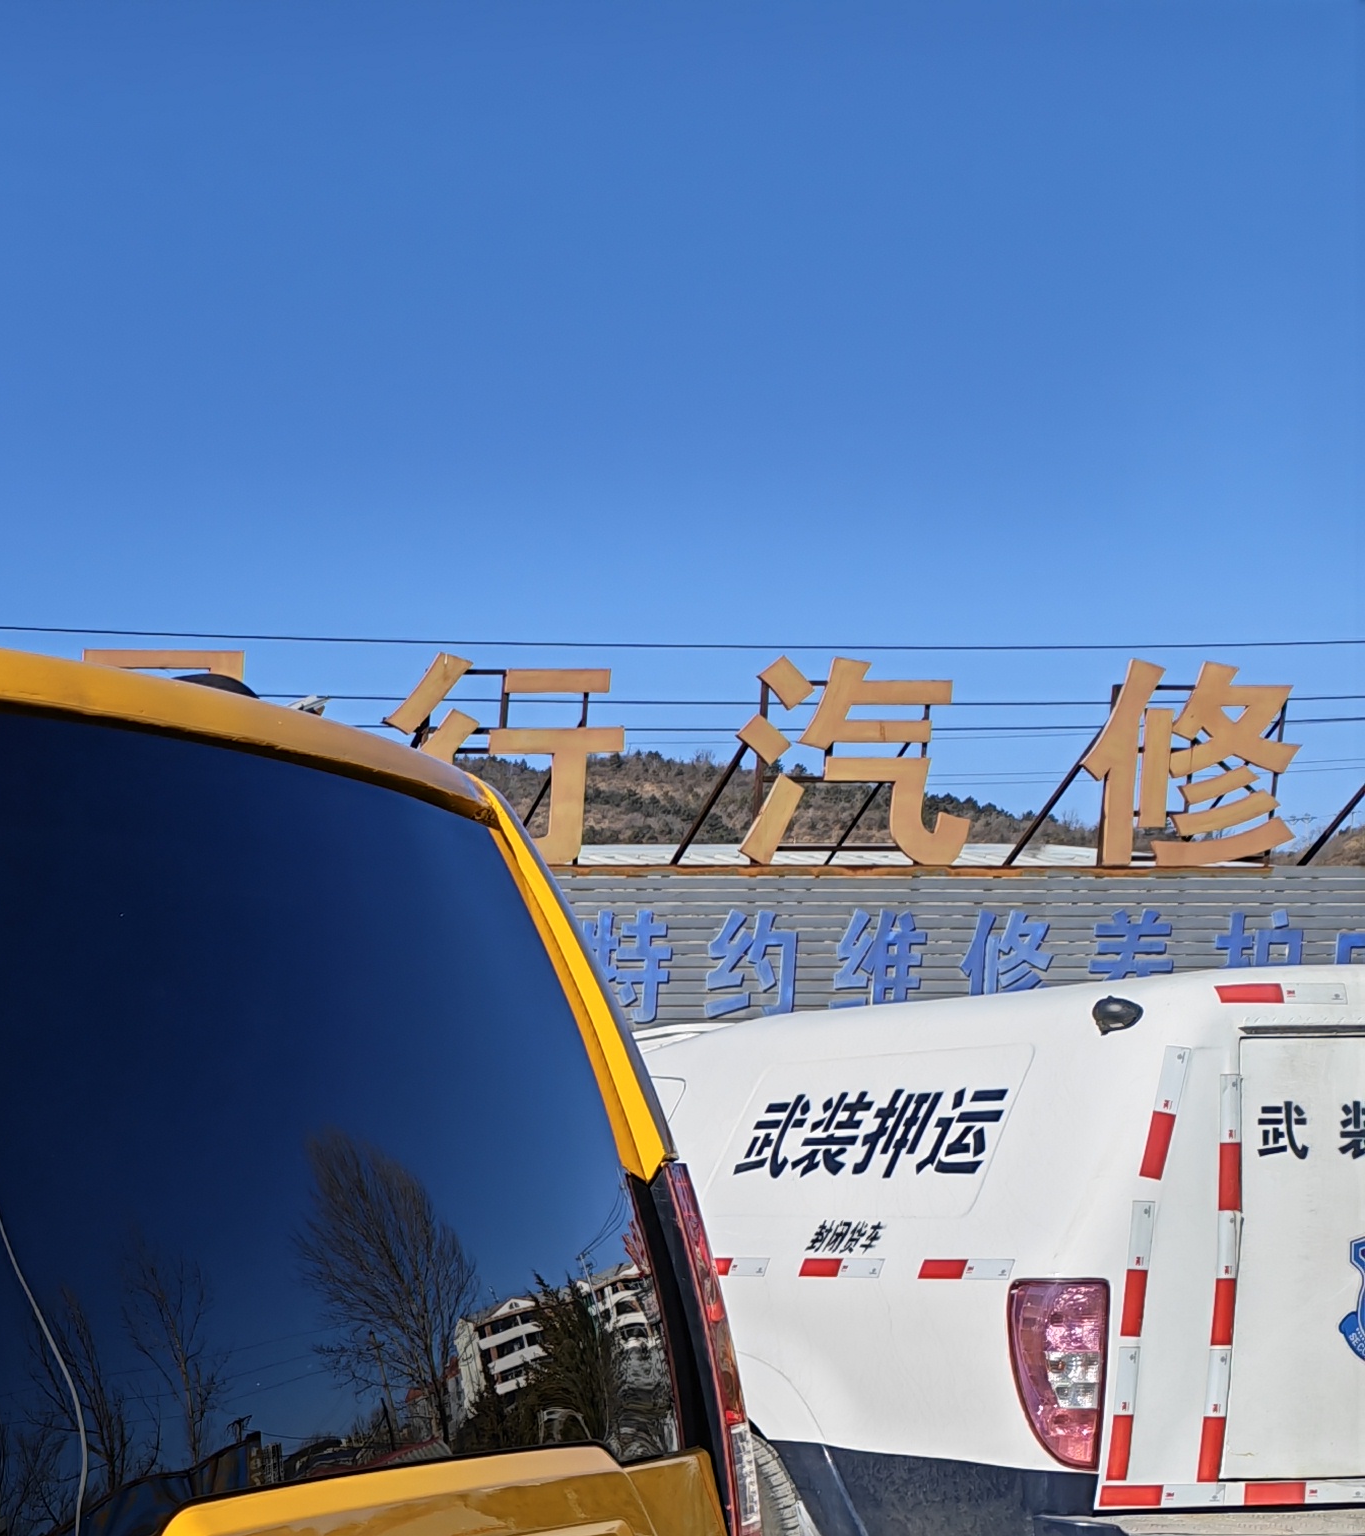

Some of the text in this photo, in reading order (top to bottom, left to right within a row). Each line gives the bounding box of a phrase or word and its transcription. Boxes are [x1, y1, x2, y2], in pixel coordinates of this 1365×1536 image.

[83, 649, 1303, 867] 行汽修
[582, 908, 1365, 1024] 特约维修养护
[732, 1087, 1009, 1179] 武装押运
[804, 1219, 887, 1254] 封闭货车
